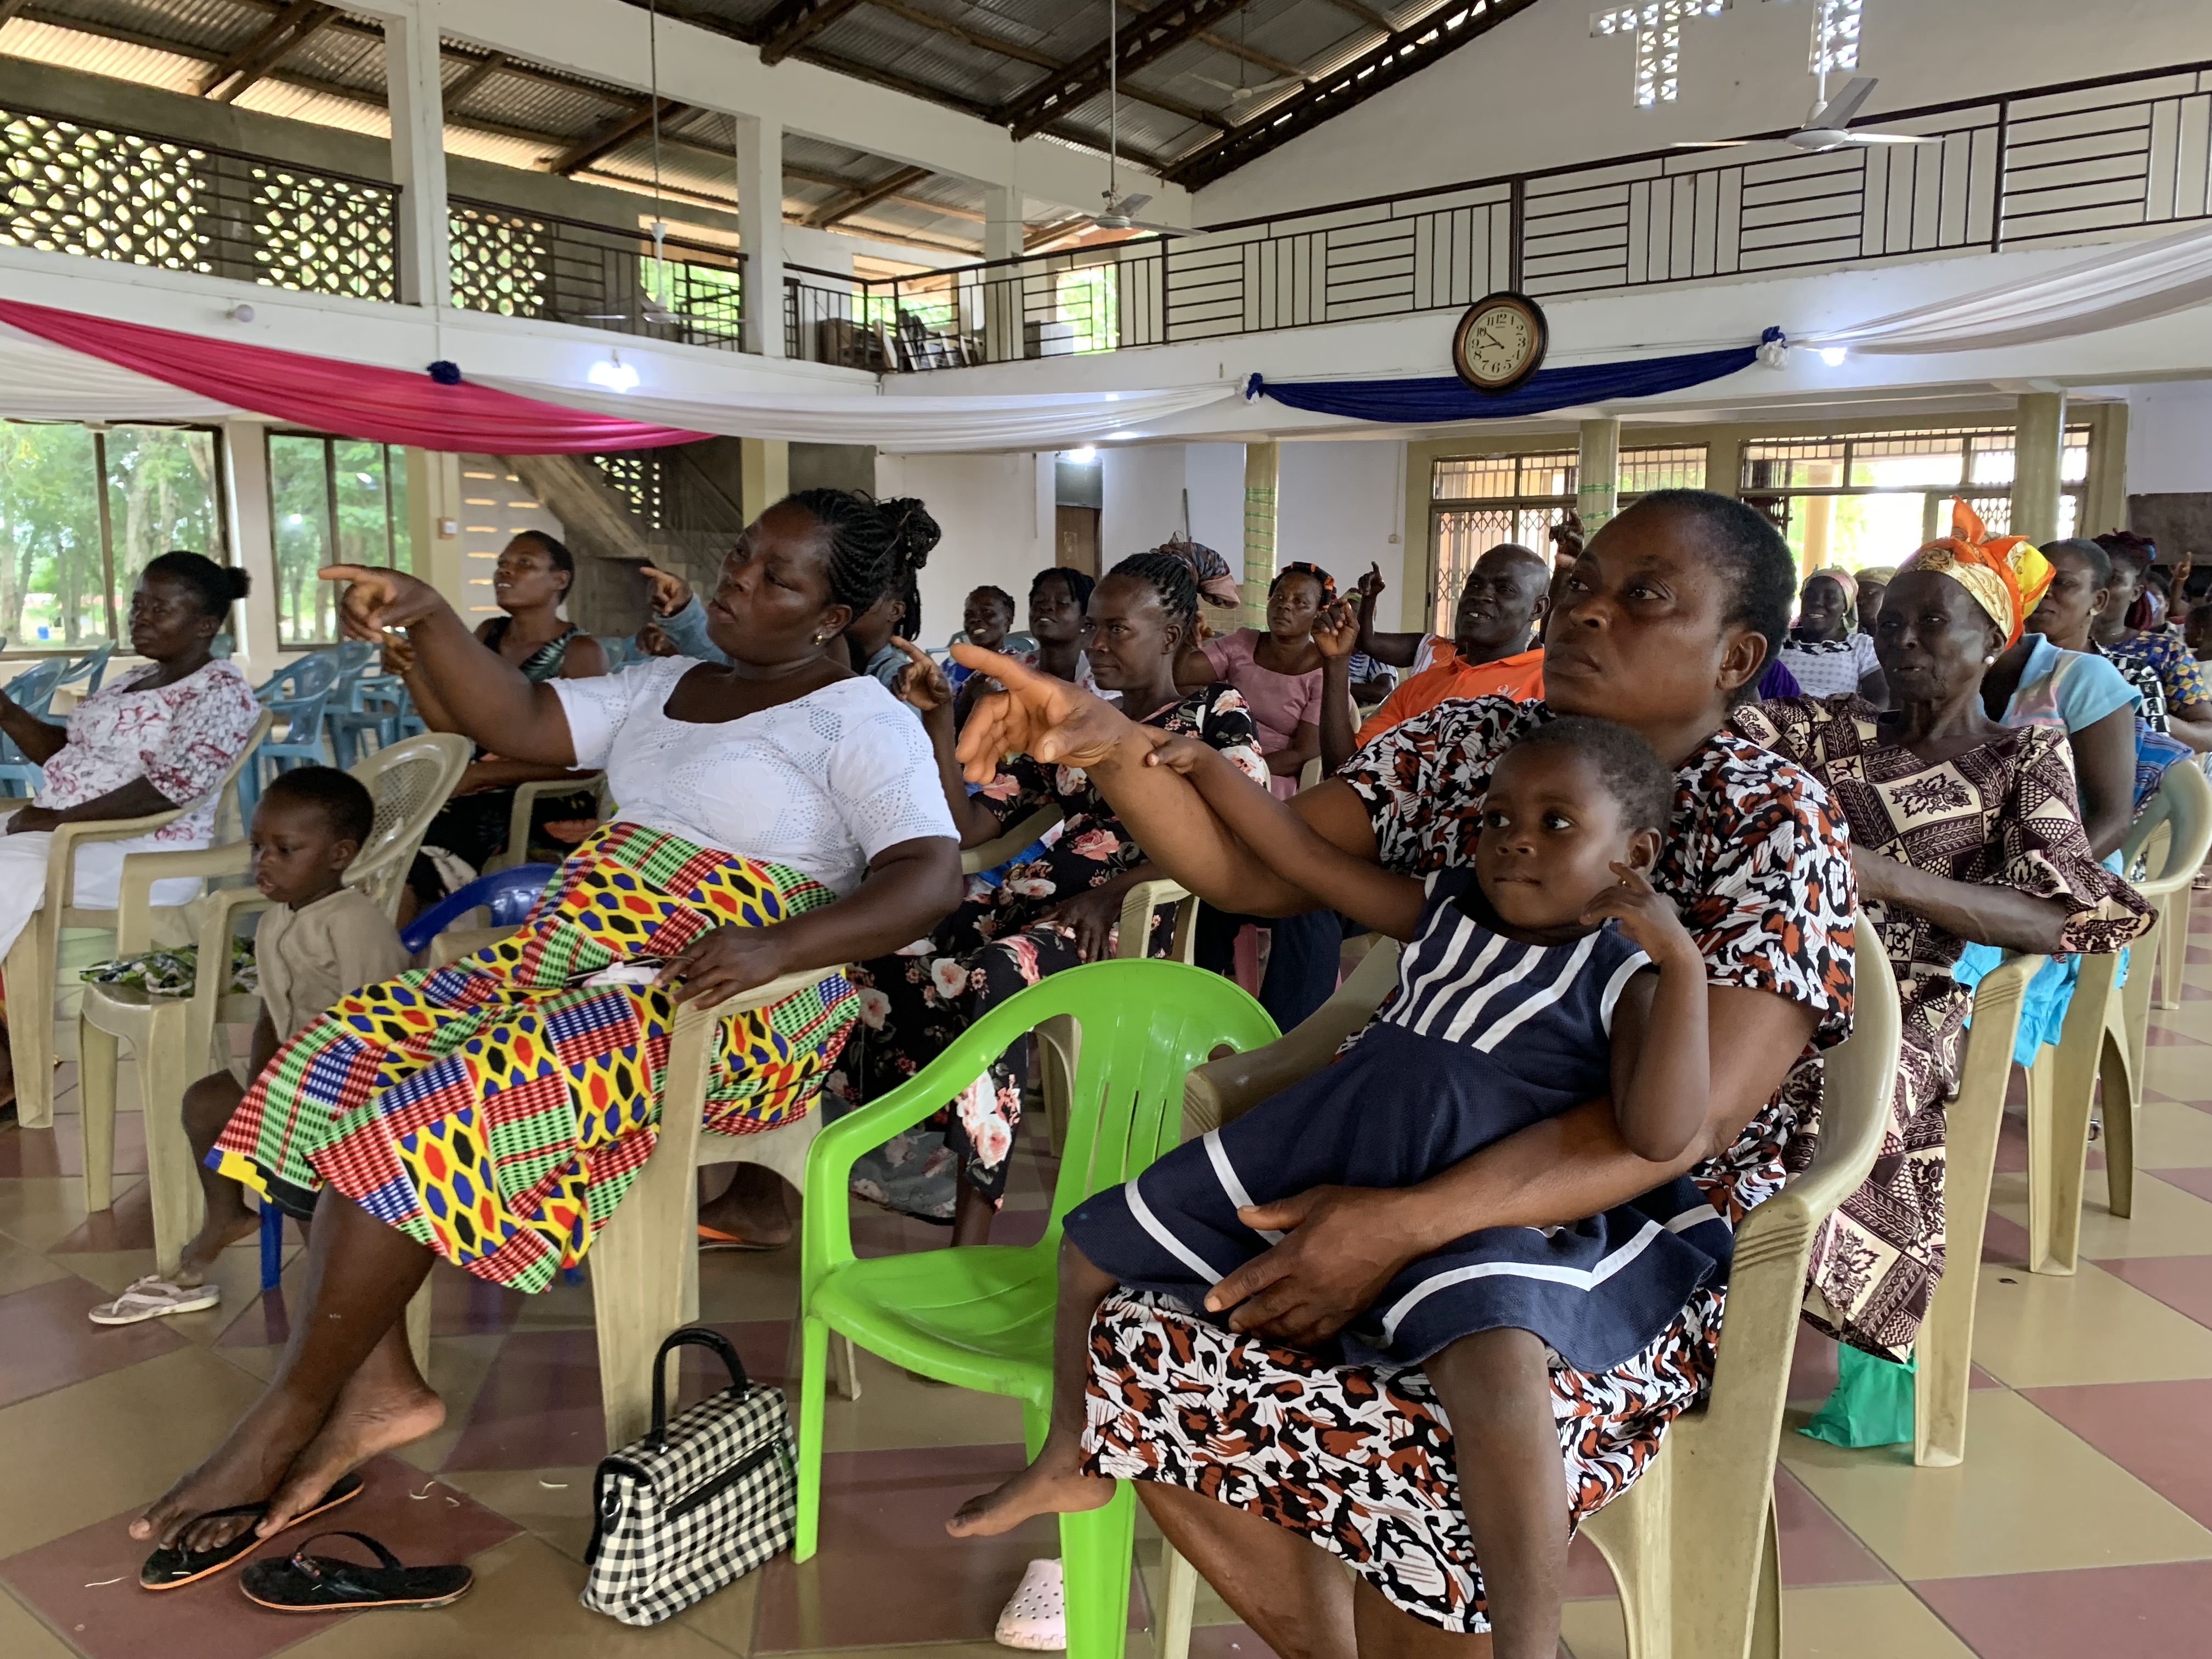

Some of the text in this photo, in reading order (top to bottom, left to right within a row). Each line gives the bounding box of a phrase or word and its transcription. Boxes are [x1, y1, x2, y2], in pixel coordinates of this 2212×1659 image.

[1487, 317, 1494, 326] 11
[1496, 314, 1507, 324] 12
[1511, 316, 1514, 325] 1
[1477, 327, 1487, 337] 10
[1516, 325, 1523, 336] 2
[1472, 338, 1480, 349] 9
[1518, 337, 1526, 347] 3
[1473, 350, 1482, 360] 8
[1512, 349, 1520, 360] 4
[1482, 360, 1489, 370] 7
[1492, 362, 1500, 373] 6
[1504, 359, 1511, 370] 5
